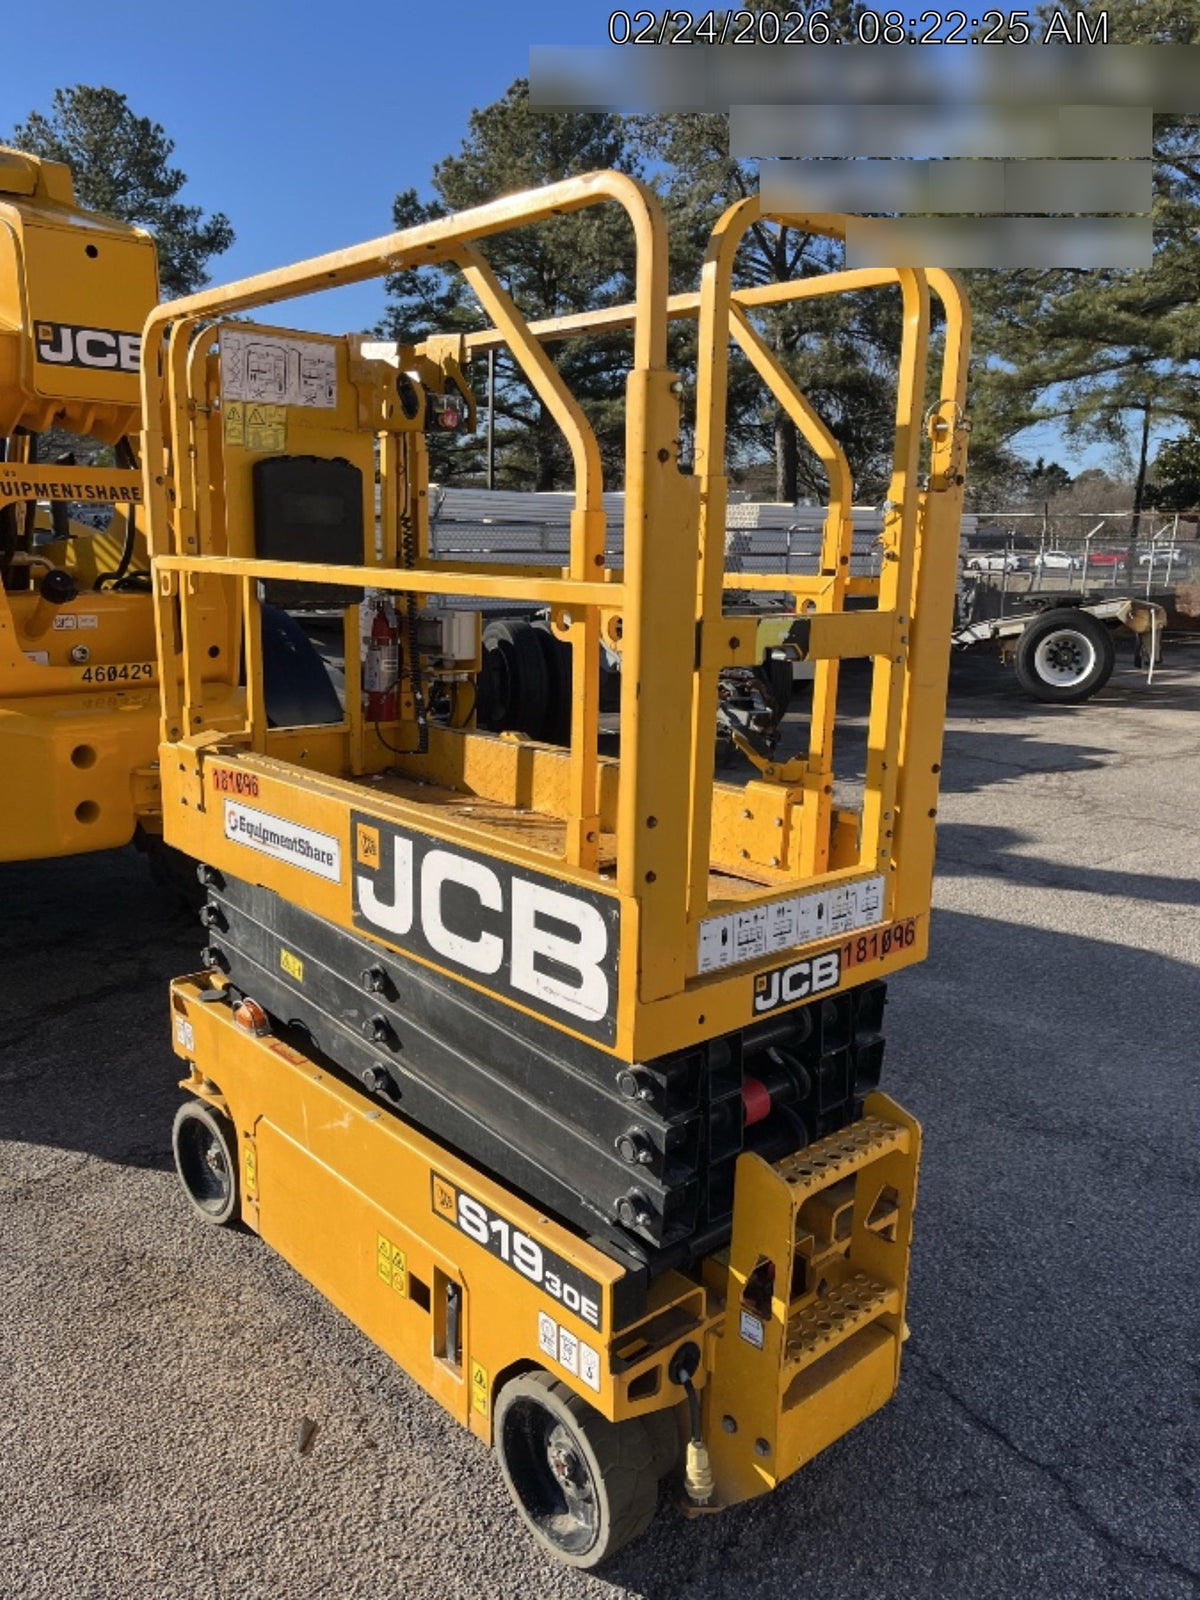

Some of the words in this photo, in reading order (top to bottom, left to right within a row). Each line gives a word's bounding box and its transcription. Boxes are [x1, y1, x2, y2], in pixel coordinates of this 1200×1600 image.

[82, 664, 153, 683] 460429
[213, 768, 259, 796] 181096
[239, 816, 333, 866] EquipmentShare
[357, 835, 608, 1021] JCB
[844, 921, 916, 966] 181096
[755, 953, 840, 1011] JCB
[458, 1193, 543, 1282] S19
[544, 1270, 599, 1327] 30E
